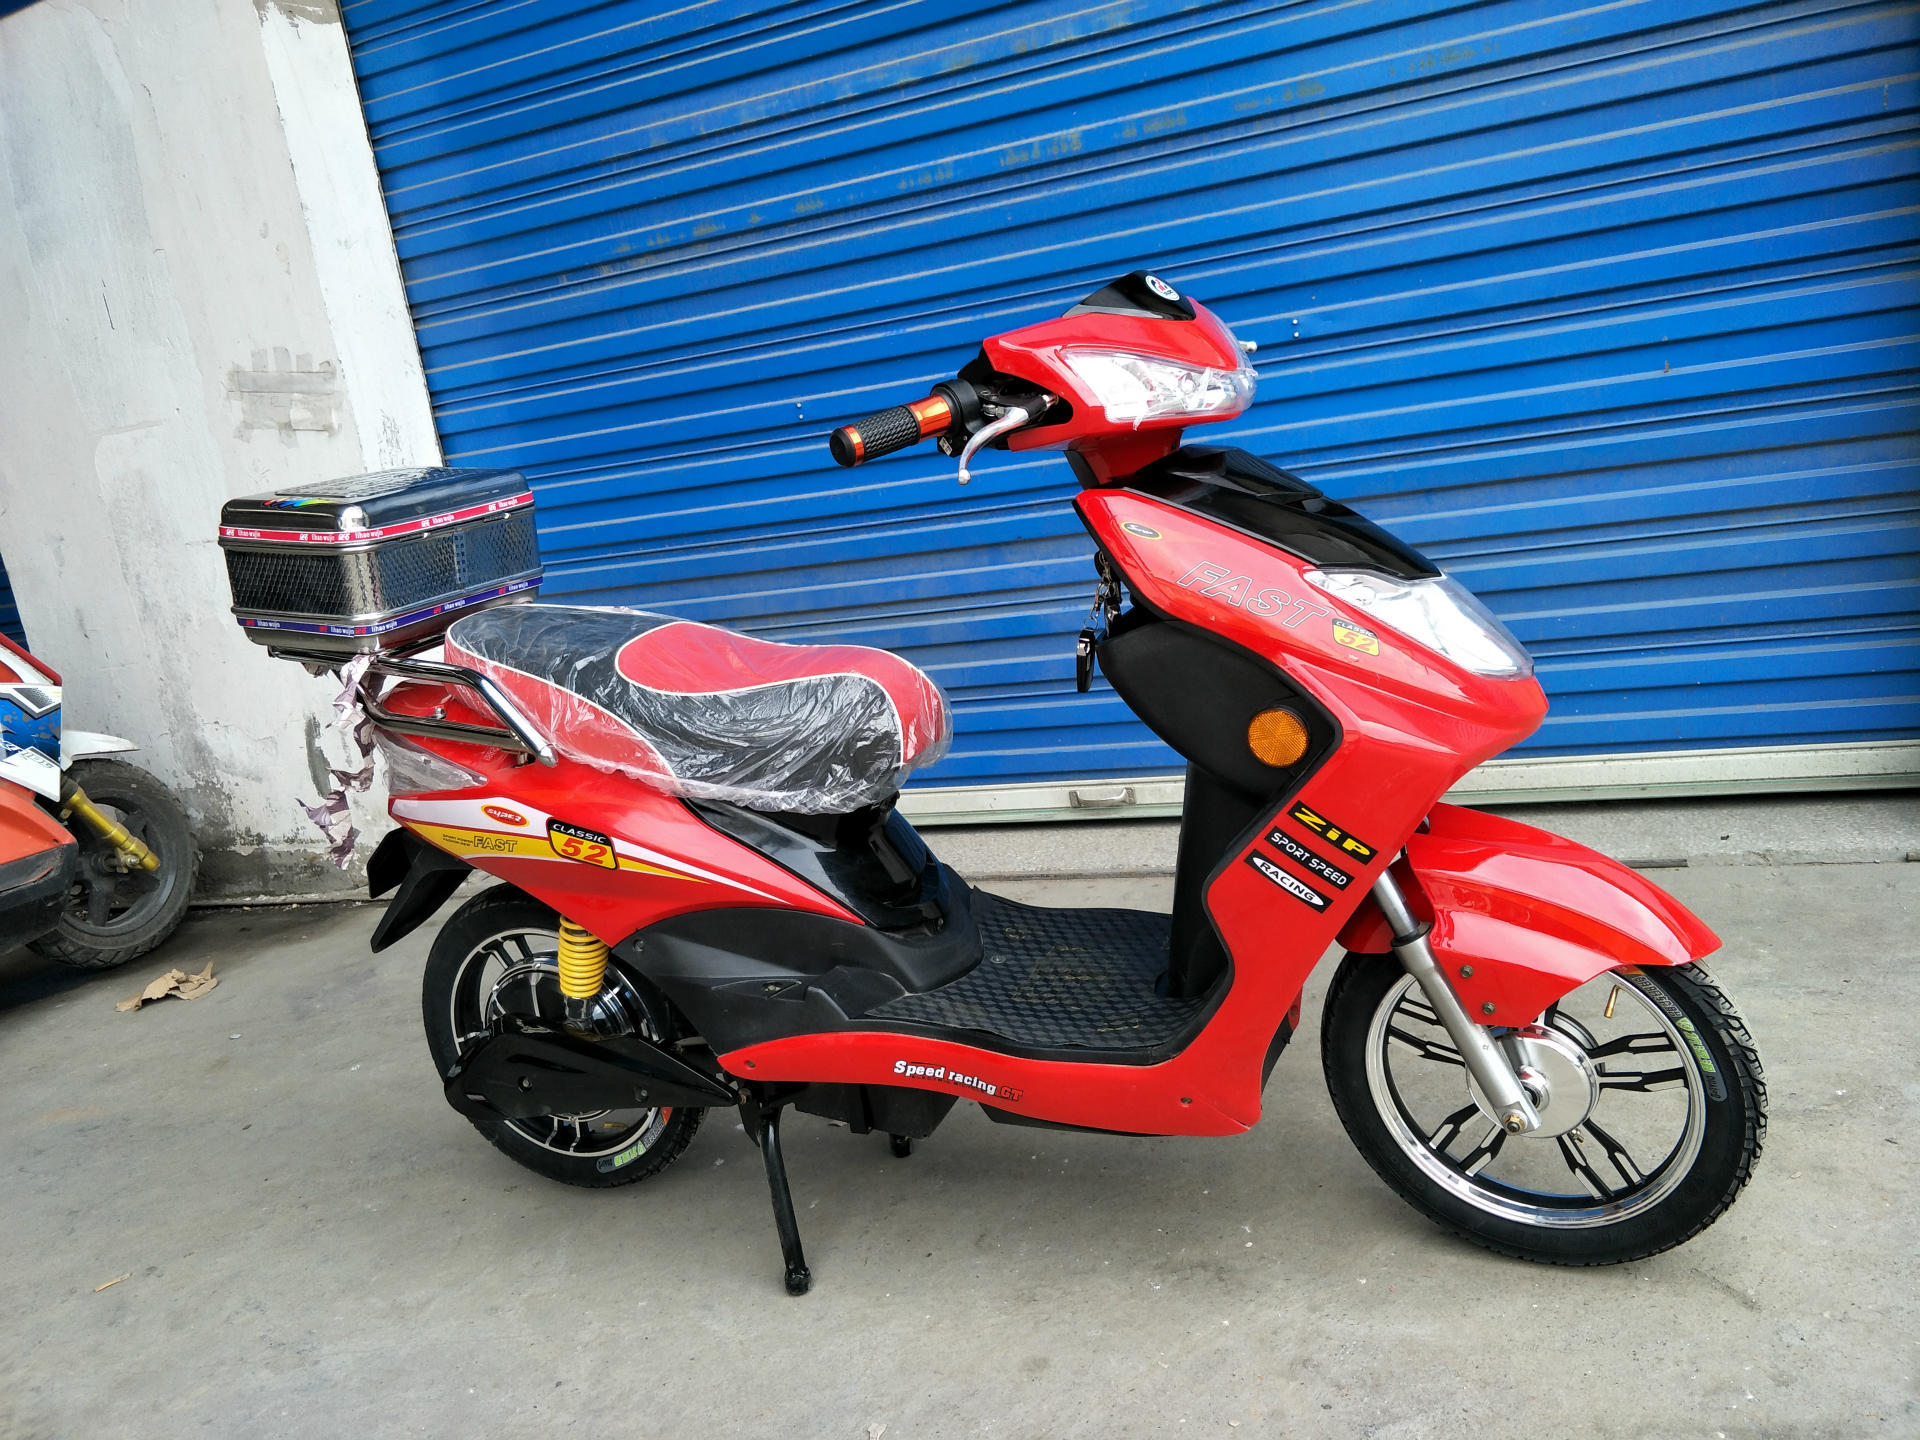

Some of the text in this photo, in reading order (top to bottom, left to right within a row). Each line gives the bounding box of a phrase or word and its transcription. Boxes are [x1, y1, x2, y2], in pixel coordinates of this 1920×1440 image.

[1176, 560, 1331, 628] FAST
[1335, 619, 1376, 638] CLASSIC
[1339, 632, 1373, 653] 52
[474, 836, 518, 853] FAST
[552, 823, 607, 844] CLASSIC
[561, 838, 609, 865] 52
[1270, 832, 1347, 886] SPORT SPEED
[1259, 862, 1316, 902] RACING
[893, 1060, 946, 1078] Speed
[947, 1070, 997, 1097] racing
[999, 1086, 1024, 1102] GT
